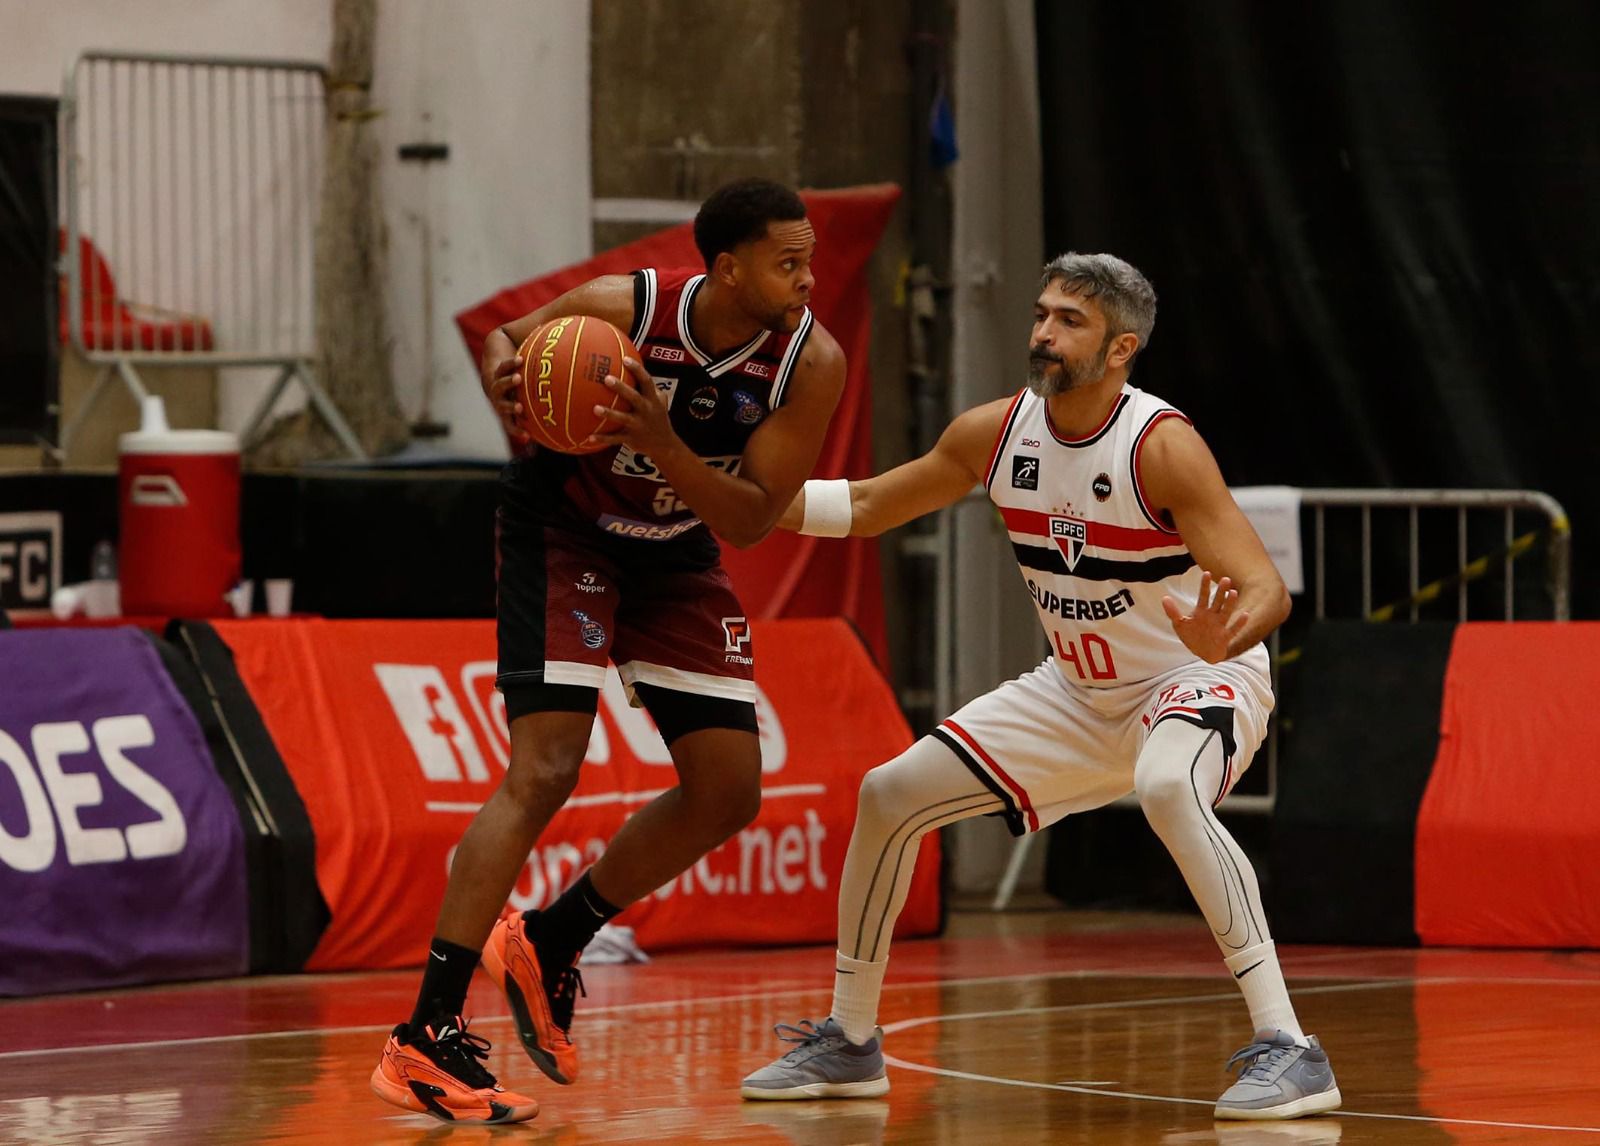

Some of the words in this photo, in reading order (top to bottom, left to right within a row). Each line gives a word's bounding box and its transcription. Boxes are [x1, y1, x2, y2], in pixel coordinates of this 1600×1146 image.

[653, 347, 682, 361] SESI
[538, 317, 574, 427] PENALTY
[652, 487, 690, 517] 5
[1054, 521, 1083, 538] SPFC
[574, 582, 606, 594] Topper
[1027, 578, 1136, 622] SUPERBET
[1053, 630, 1119, 682] 40
